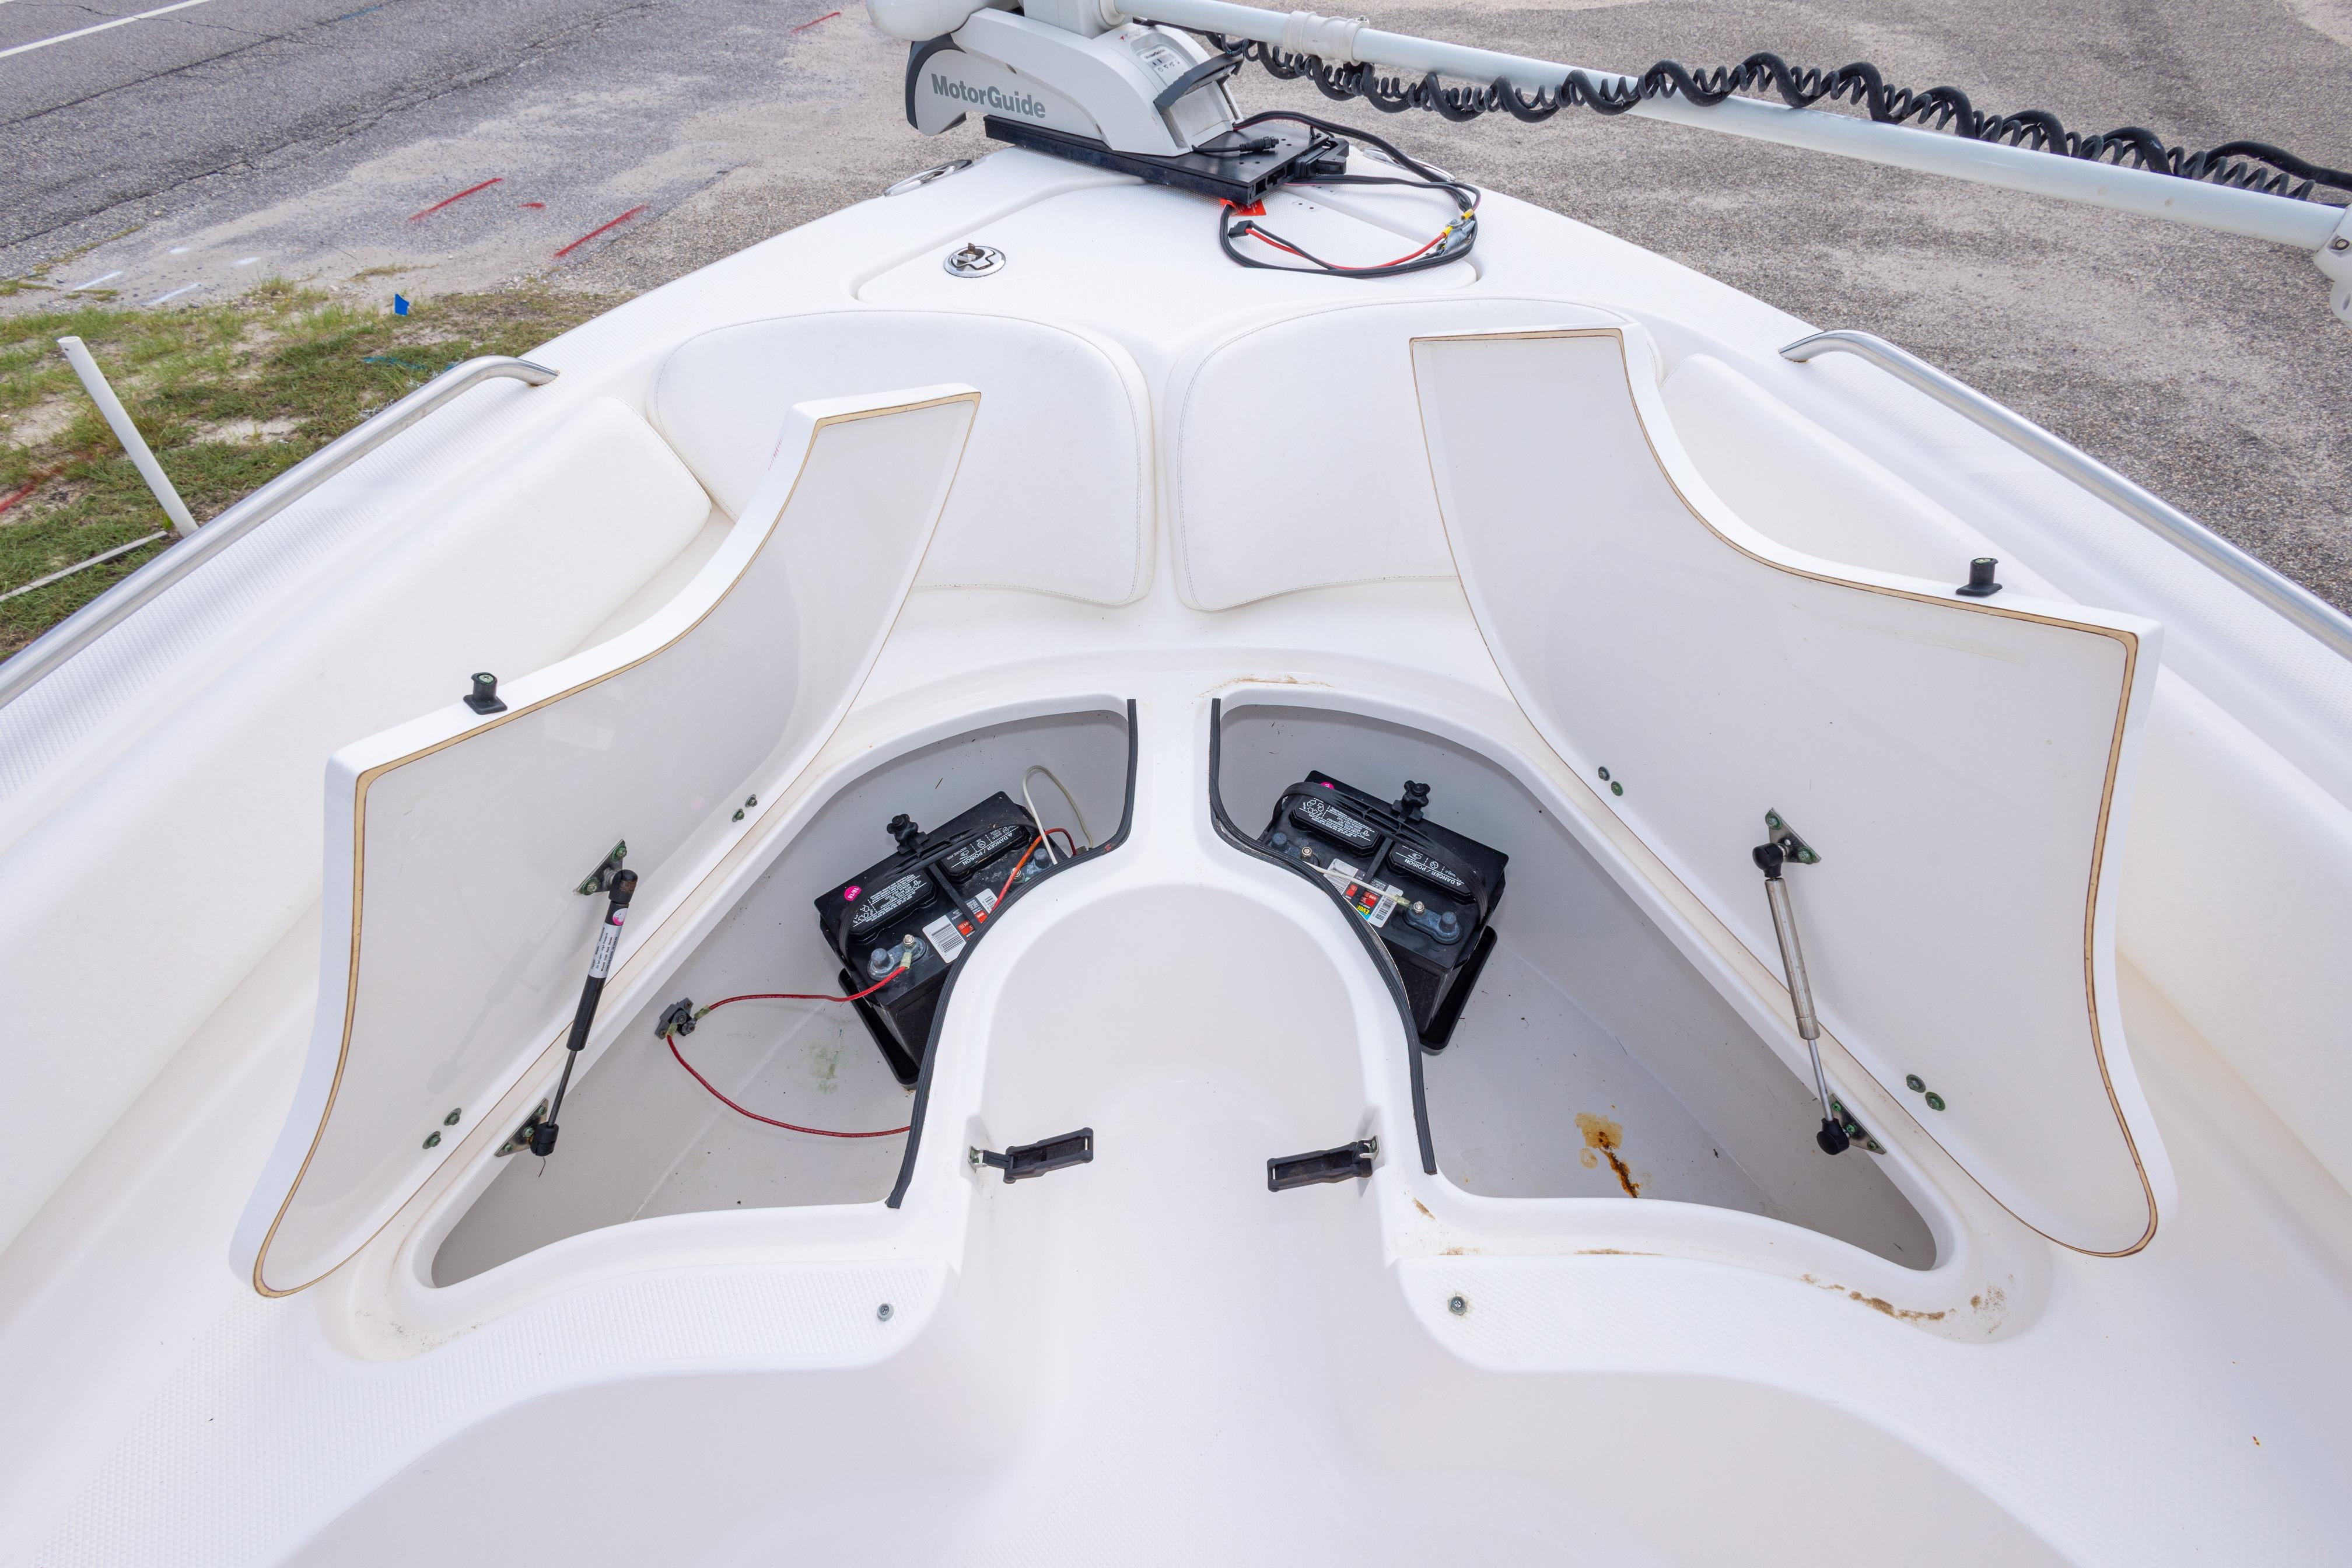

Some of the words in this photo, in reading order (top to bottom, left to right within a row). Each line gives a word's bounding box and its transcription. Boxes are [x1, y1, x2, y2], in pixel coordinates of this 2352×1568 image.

[931, 73, 1046, 118] MotorGuide
[986, 835, 1008, 851] DANGER
[962, 851, 983, 866] POISON
[1404, 859, 1426, 871] POISON
[1431, 871, 1455, 884] DANGER
[848, 888, 859, 898] 10/18
